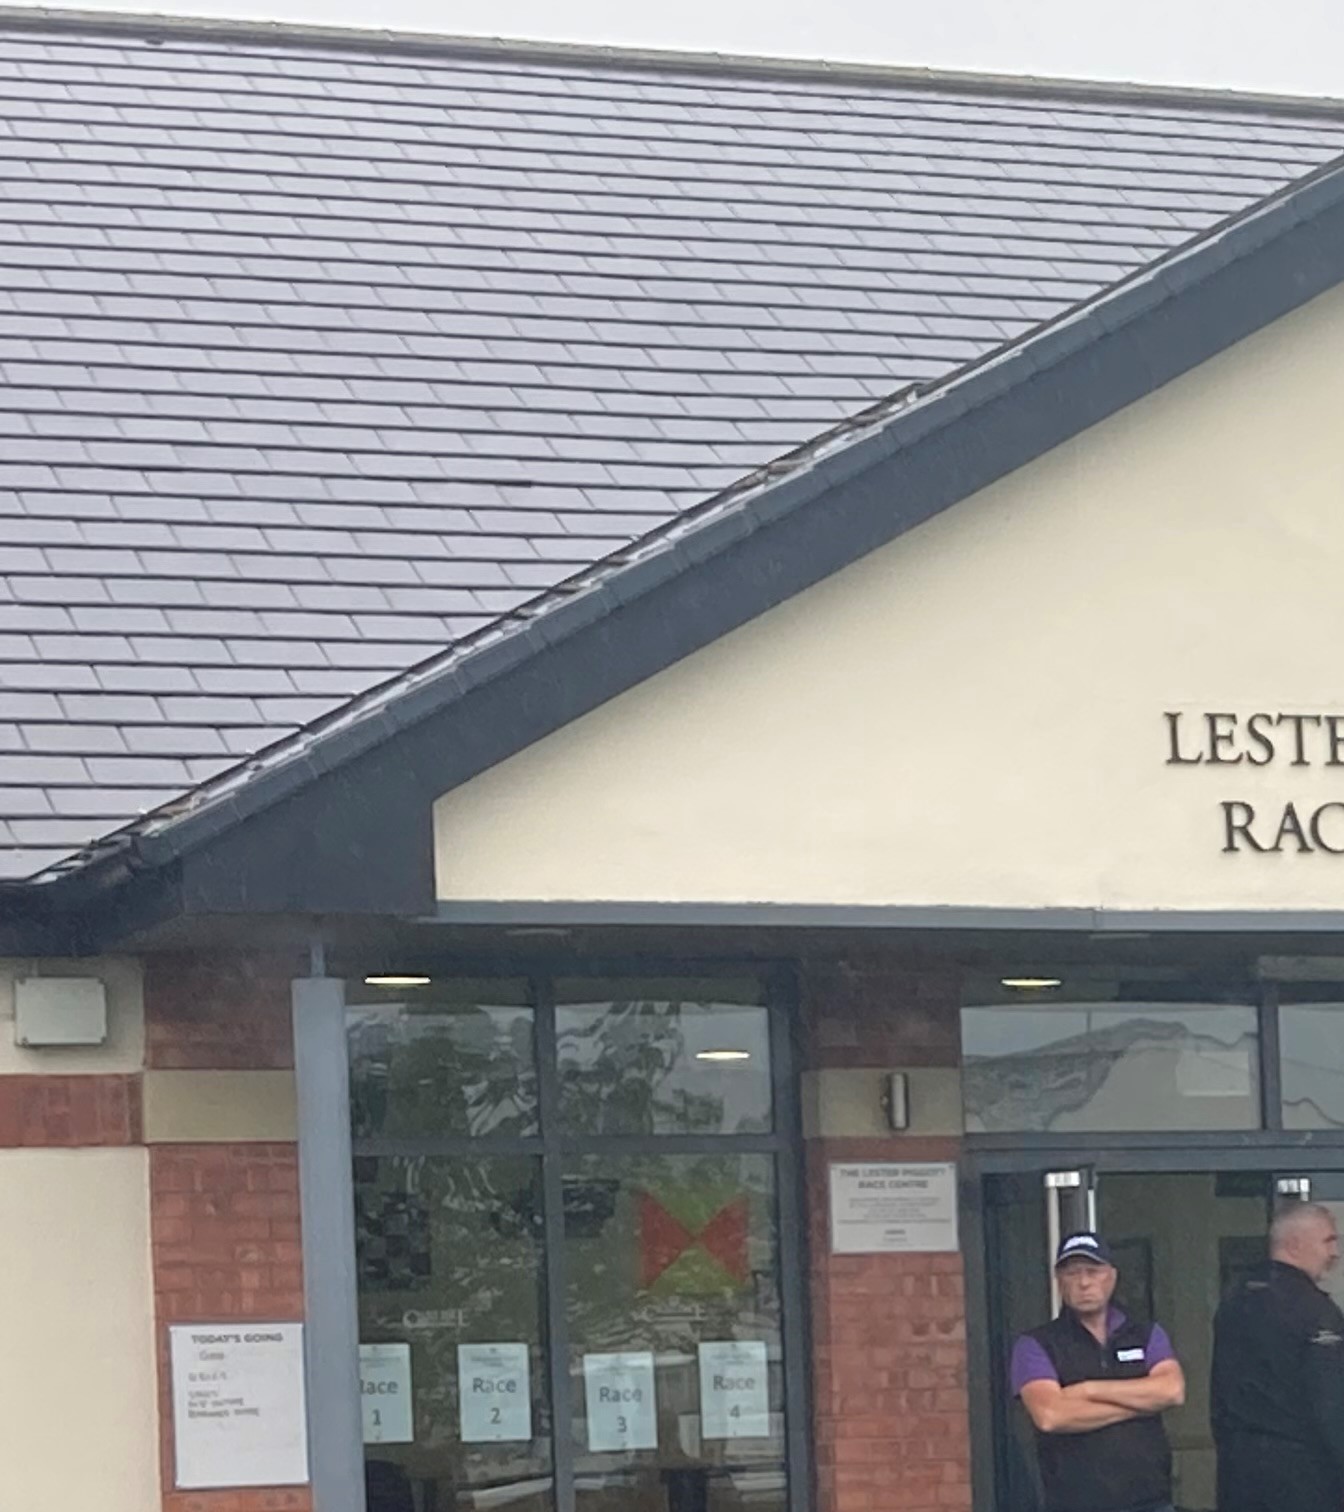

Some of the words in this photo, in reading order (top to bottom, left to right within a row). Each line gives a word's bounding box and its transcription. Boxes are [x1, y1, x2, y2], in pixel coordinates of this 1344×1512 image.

[472, 1377, 517, 1394] Race
[712, 1375, 756, 1391] Race
[599, 1386, 643, 1403] Race
[372, 1409, 382, 1426] 1
[490, 1407, 502, 1425] 2
[729, 1404, 741, 1419] 4
[616, 1415, 628, 1434] 3
